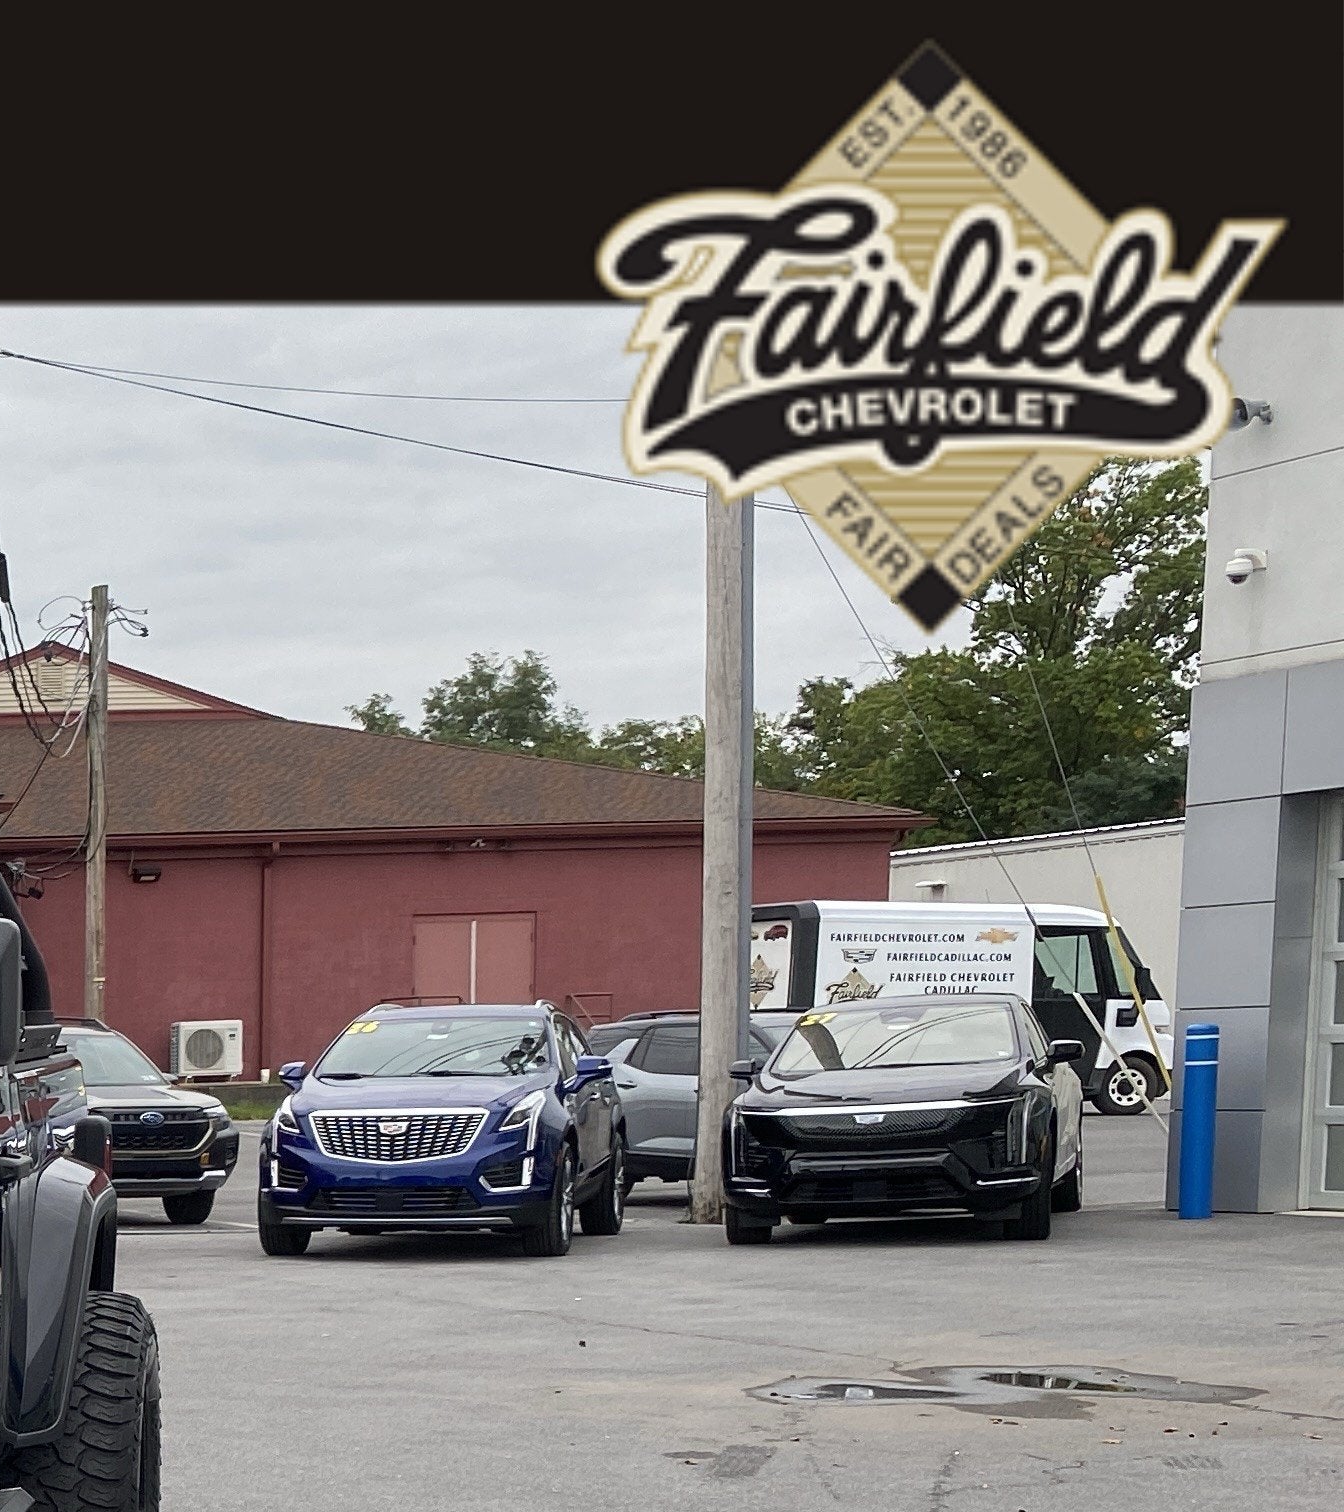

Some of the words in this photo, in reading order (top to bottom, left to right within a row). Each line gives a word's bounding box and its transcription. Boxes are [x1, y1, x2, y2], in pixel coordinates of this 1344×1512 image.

[830, 933, 965, 943] FAIRFIELDCHEVROLET.COM
[886, 952, 1012, 962] FAIRFIELDCADILLAC.COM
[890, 972, 946, 982] FAIRFIELD
[950, 972, 1015, 982] CHEVROLET
[825, 981, 885, 1004] Fairfield
[924, 985, 979, 994] CADILLAC
